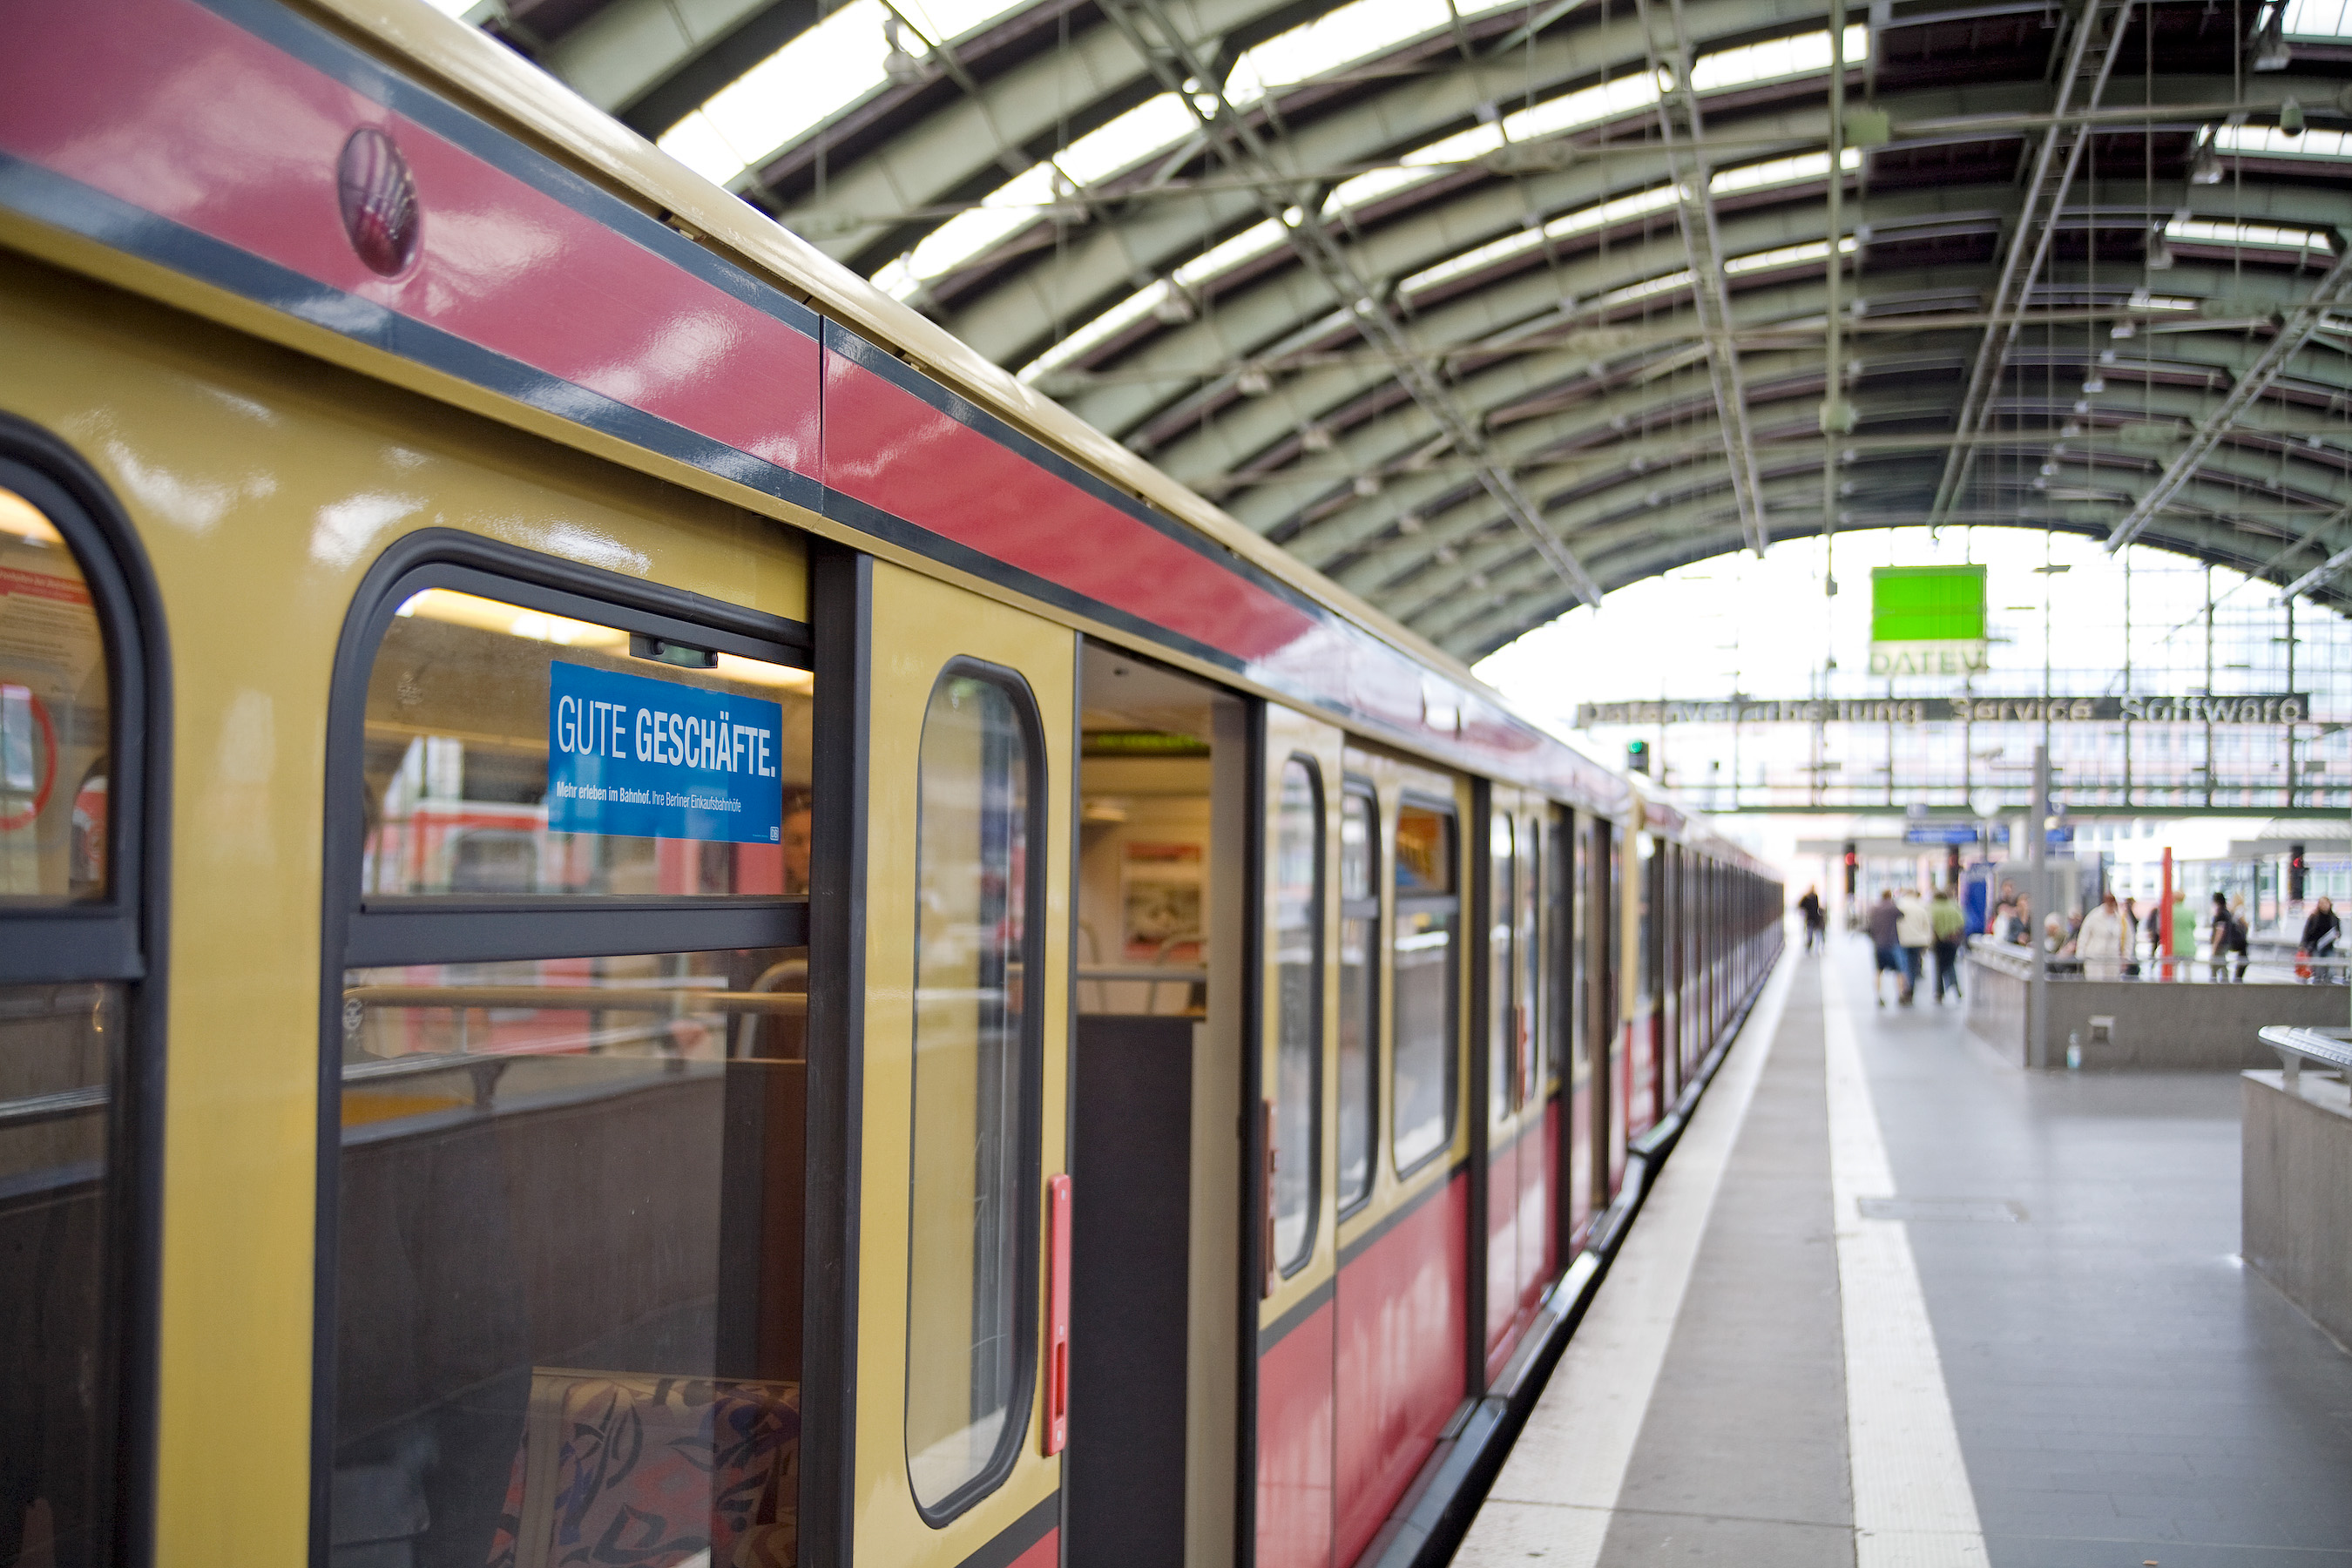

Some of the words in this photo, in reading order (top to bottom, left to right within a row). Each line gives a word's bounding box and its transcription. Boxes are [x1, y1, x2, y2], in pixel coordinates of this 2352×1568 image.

[1869, 650, 1984, 676] DATEV
[1949, 694, 2092, 722] Service
[2119, 693, 2302, 726] Software
[558, 695, 626, 758] GUTE
[635, 708, 775, 777] GESCHÄFTE.
[556, 781, 578, 799] Mehr
[578, 783, 607, 801] erleben
[608, 786, 618, 802] im
[619, 787, 652, 805] Bahnhof.
[652, 790, 665, 806] Ihre
[666, 791, 690, 808] Berliner
